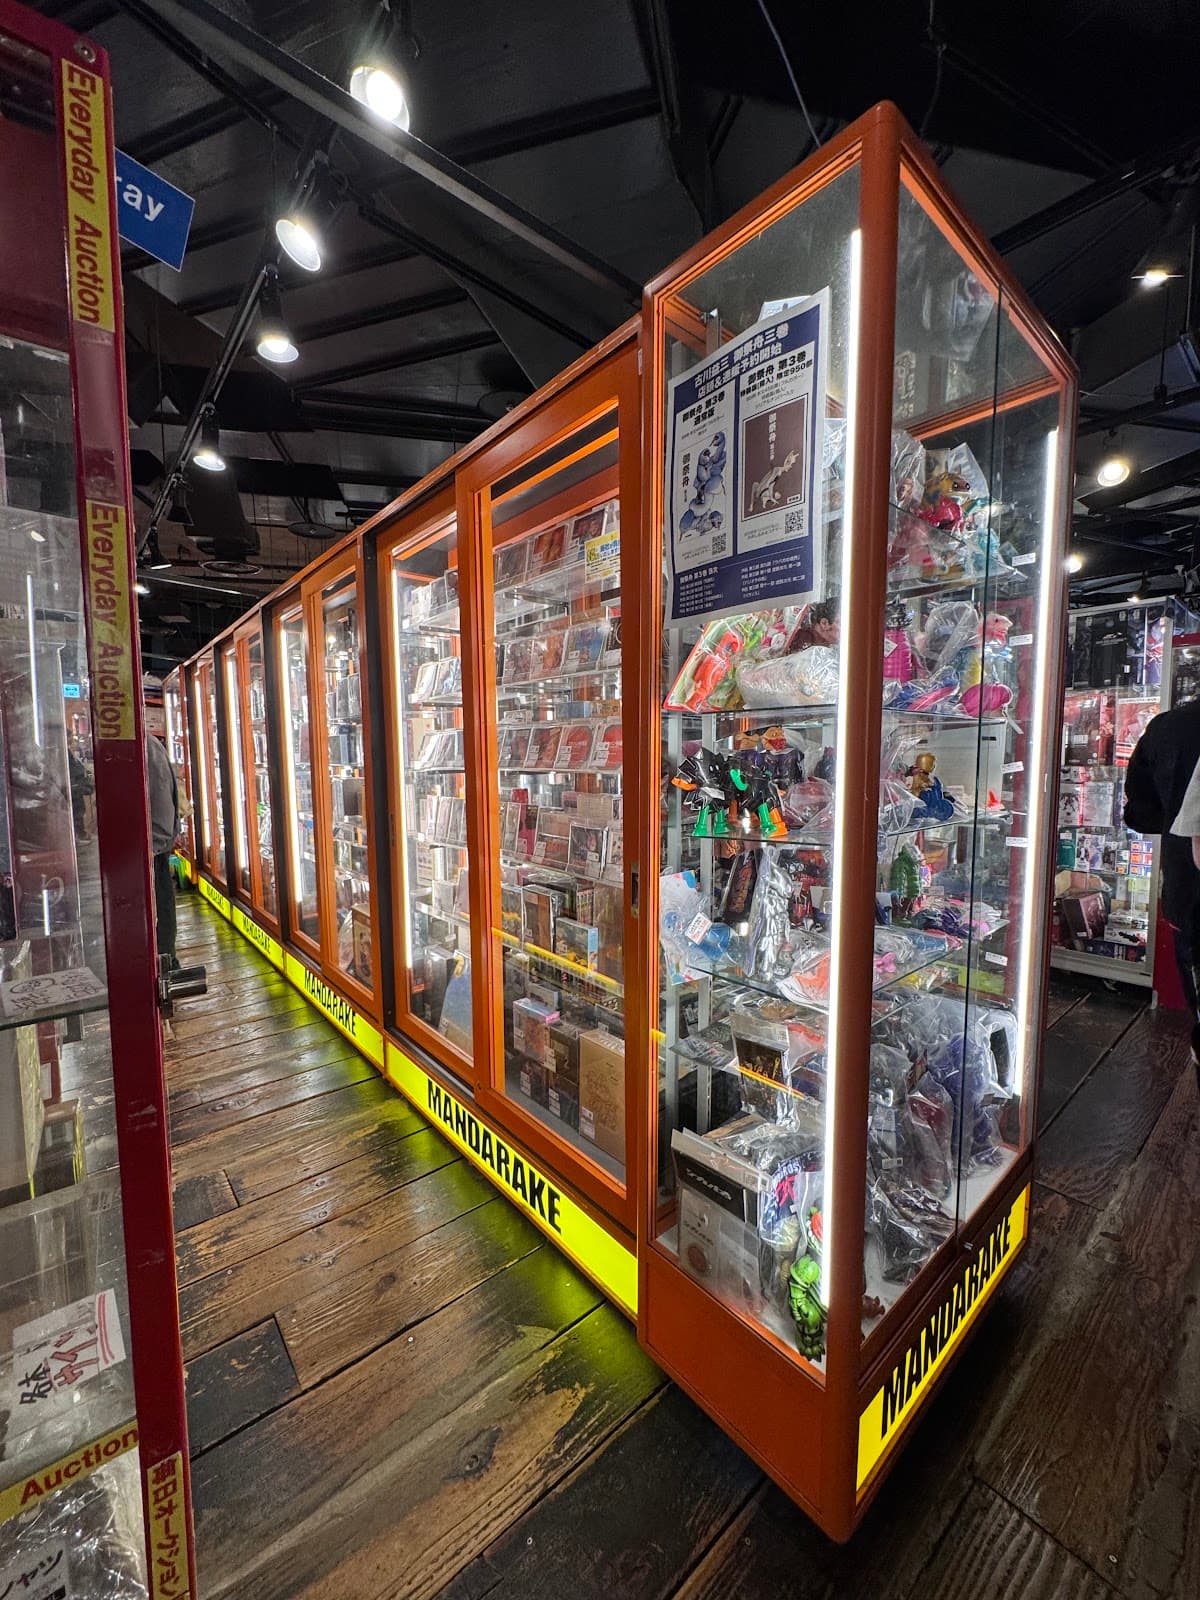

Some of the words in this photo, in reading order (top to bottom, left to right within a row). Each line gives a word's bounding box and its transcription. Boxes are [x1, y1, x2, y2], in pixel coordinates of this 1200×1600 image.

[67, 64, 100, 204] Everyday
[74, 215, 102, 324] Auction
[90, 503, 122, 626] Everyday
[97, 645, 126, 739] Auction
[303, 969, 357, 1038] MANDARAKE
[426, 1078, 562, 1236] MANDARAKE
[880, 1210, 1011, 1441] MANDARAKE
[20, 1428, 138, 1505] Auction
